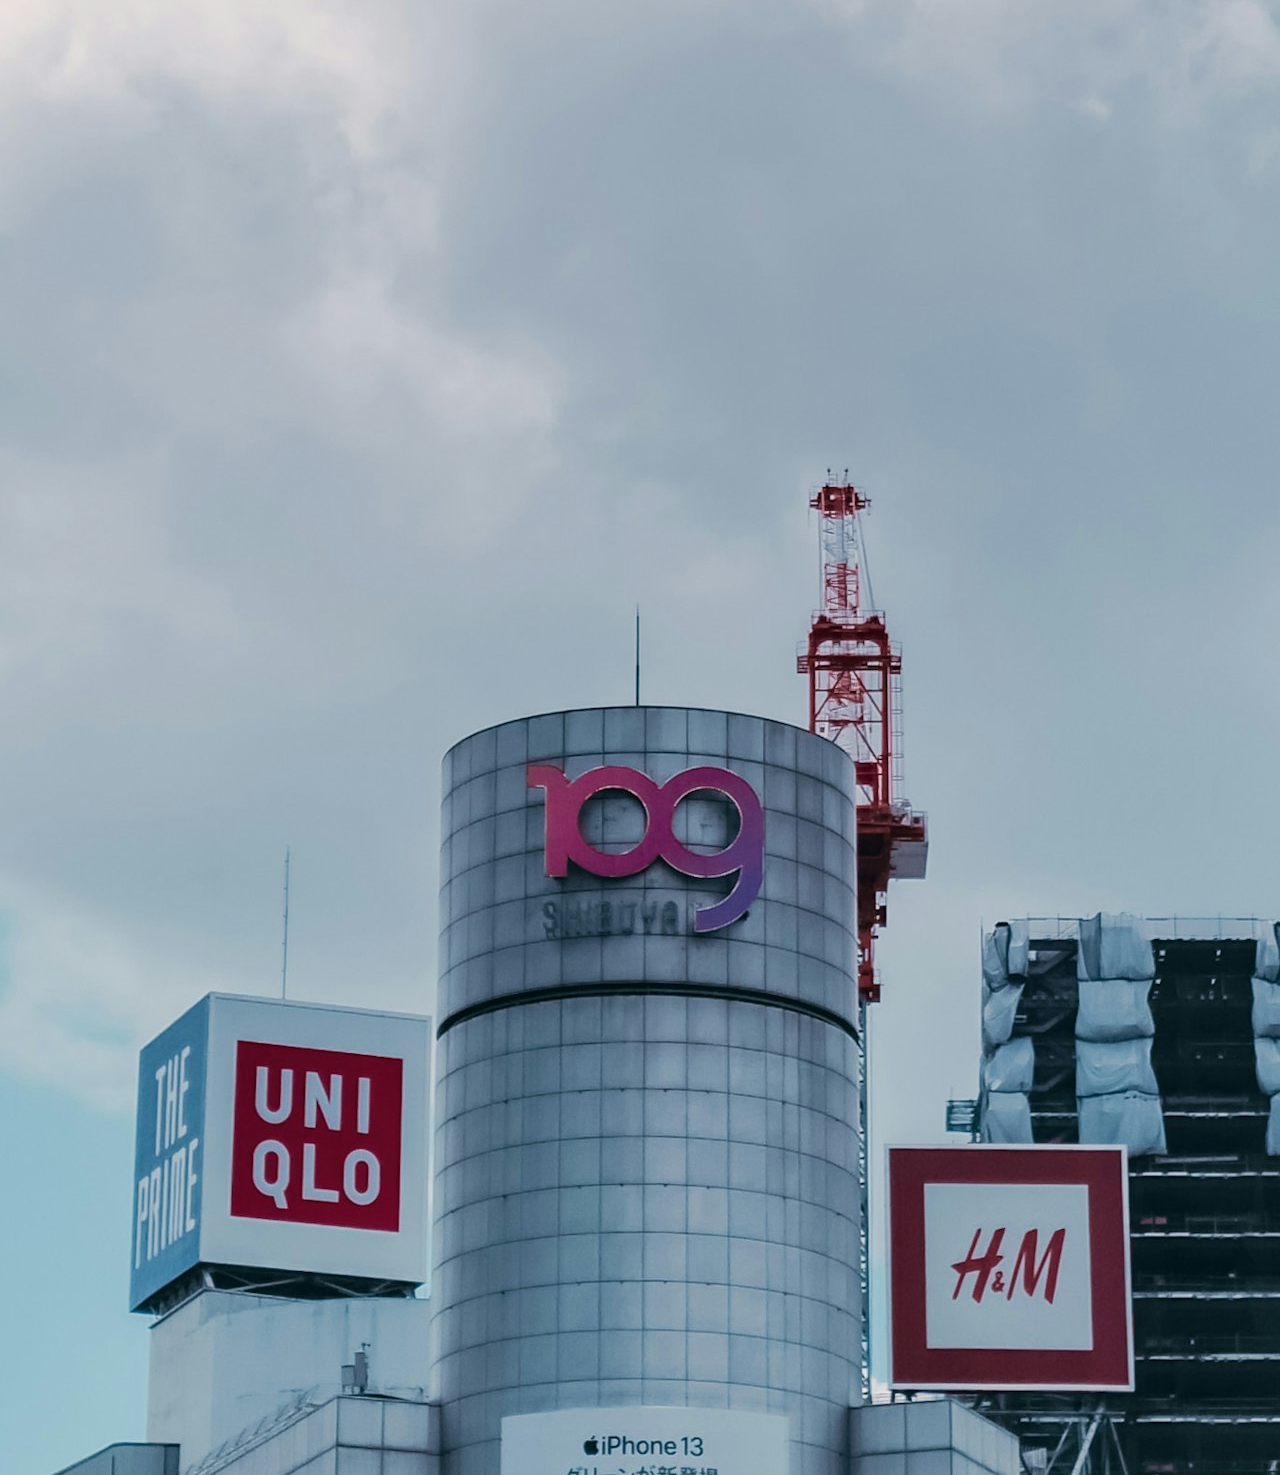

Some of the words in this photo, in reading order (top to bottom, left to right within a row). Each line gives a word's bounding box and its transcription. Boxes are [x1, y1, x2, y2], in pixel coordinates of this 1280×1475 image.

[525, 764, 766, 935] 109
[155, 1045, 191, 1157] THE
[254, 1065, 372, 1134] UNI
[134, 1137, 199, 1270] PRIME
[251, 1138, 381, 1210] QLO
[950, 1227, 1067, 1305] H&M
[601, 1436, 677, 1456] iPhone
[681, 1437, 705, 1456] 13
